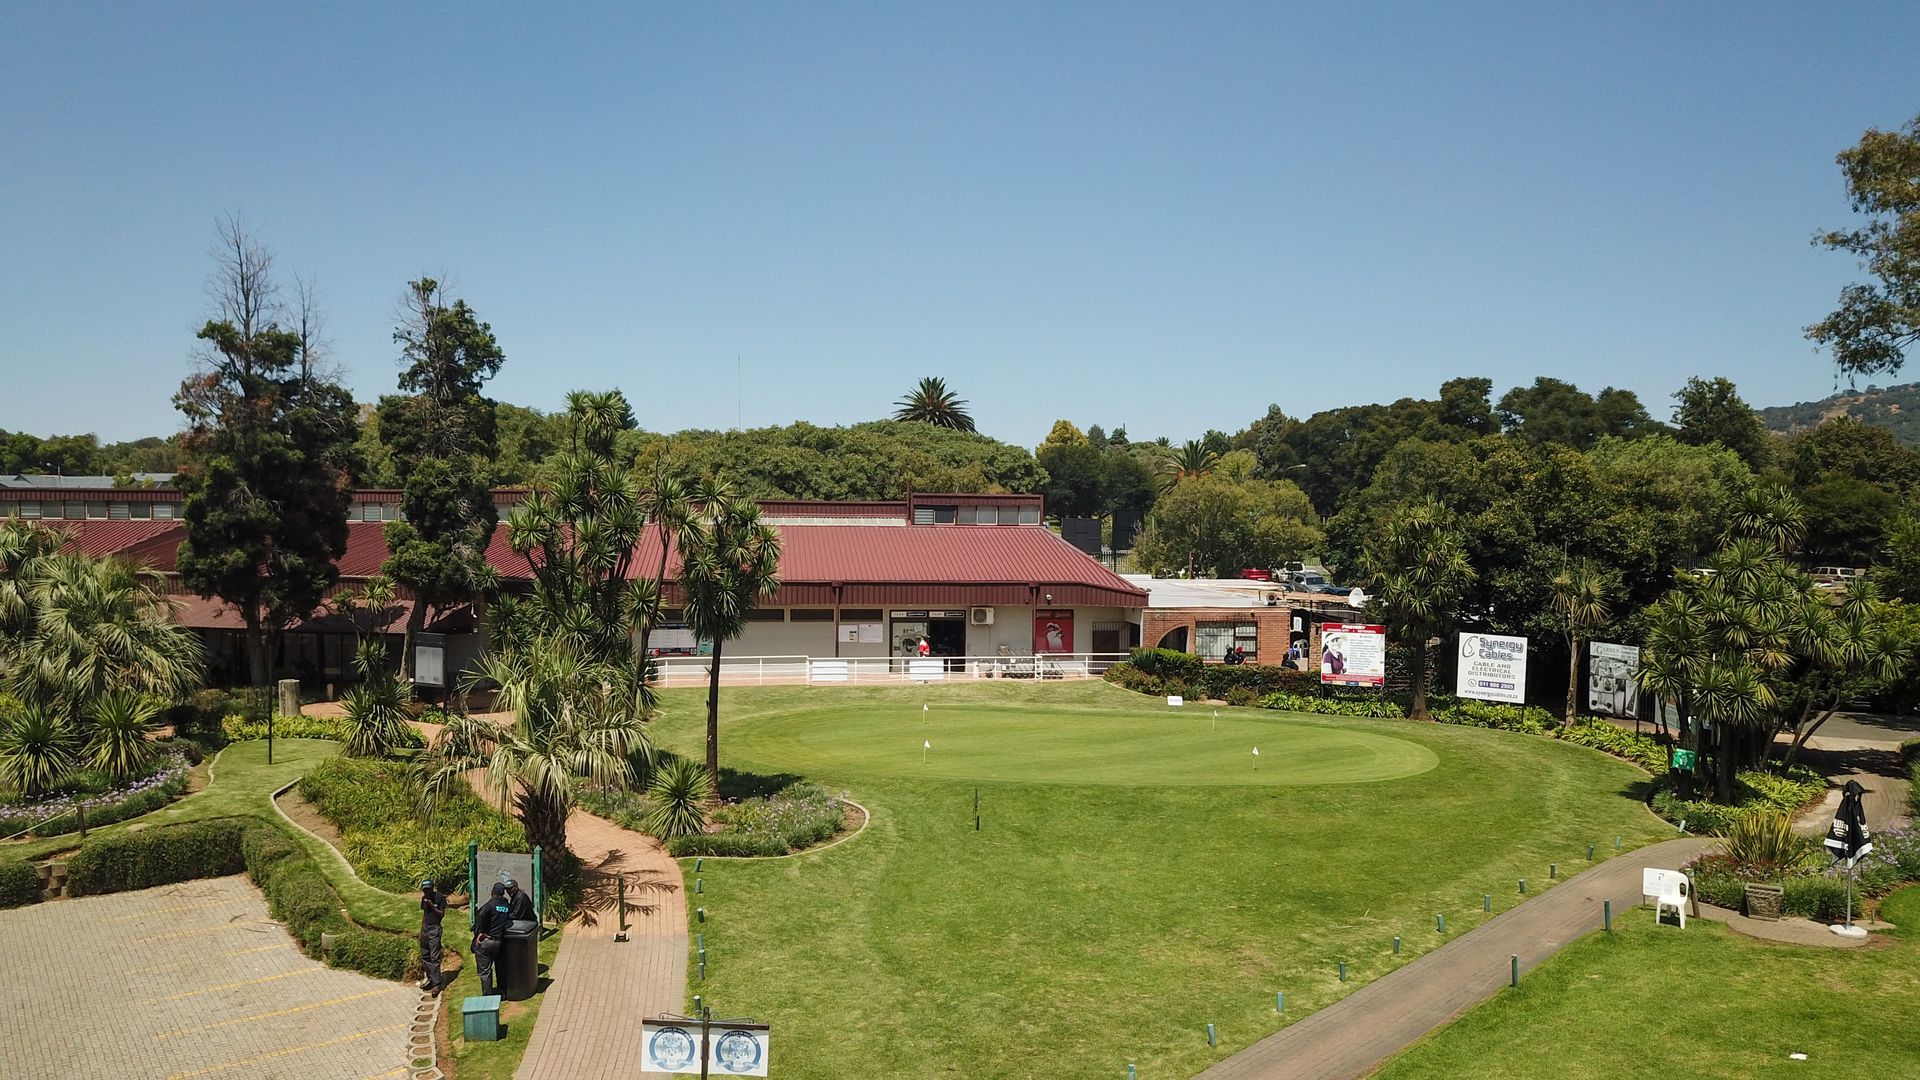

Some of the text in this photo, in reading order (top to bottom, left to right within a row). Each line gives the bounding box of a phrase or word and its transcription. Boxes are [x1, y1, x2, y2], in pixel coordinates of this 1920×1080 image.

[1479, 637, 1524, 653] Synergy
[1479, 648, 1513, 661] Cables
[1467, 670, 1516, 680] DISTRIBUTORS
[1471, 666, 1512, 674] ELECTRICAL
